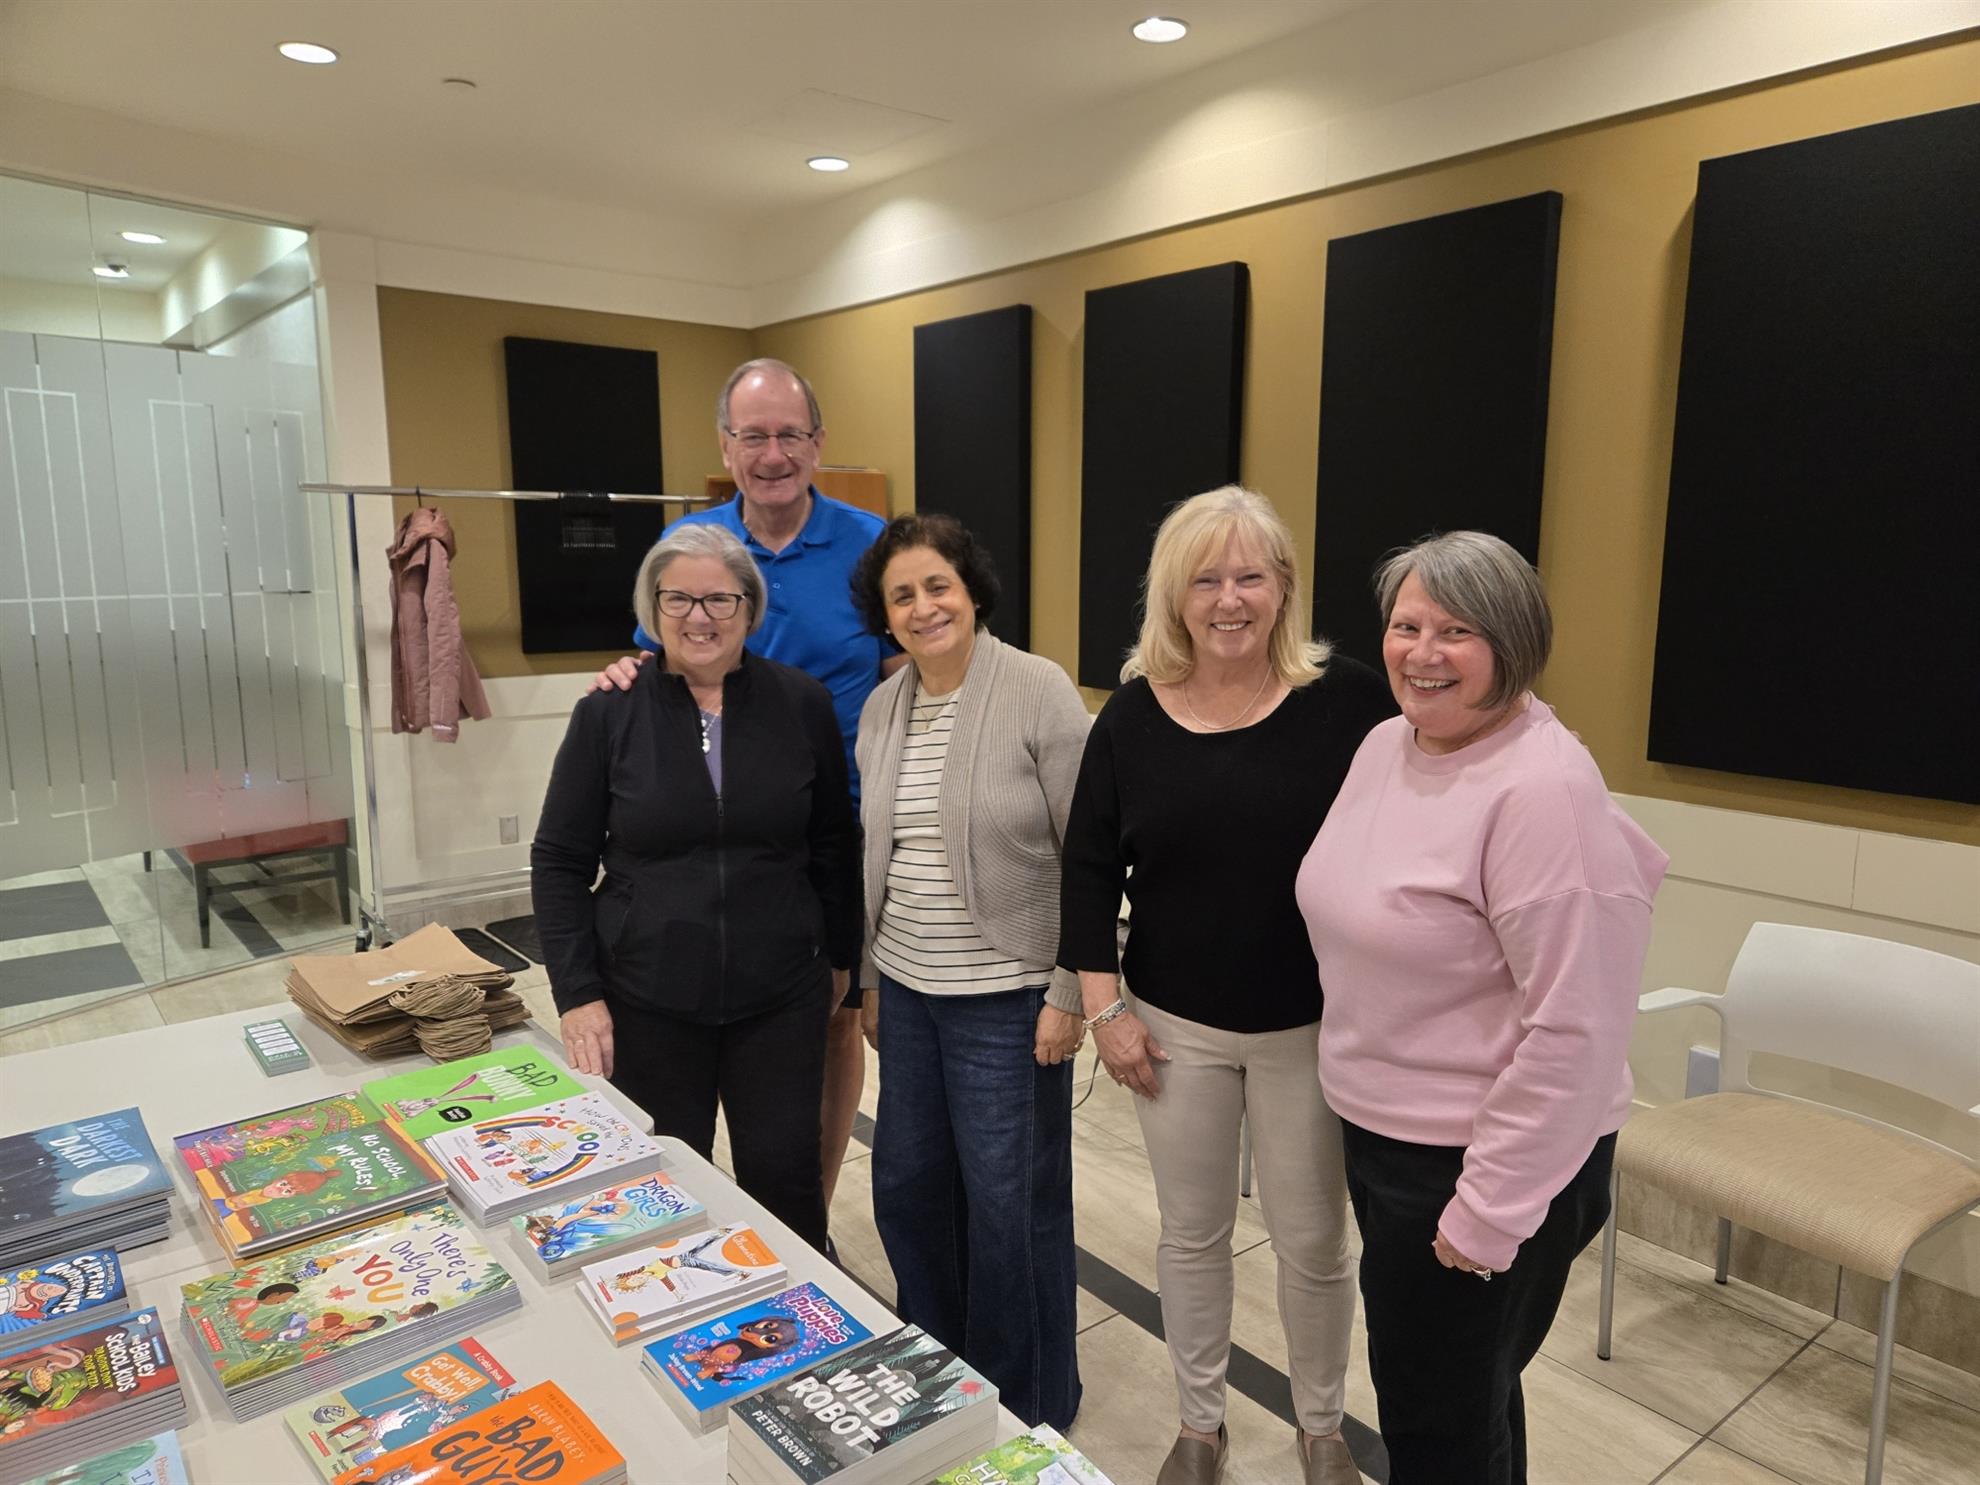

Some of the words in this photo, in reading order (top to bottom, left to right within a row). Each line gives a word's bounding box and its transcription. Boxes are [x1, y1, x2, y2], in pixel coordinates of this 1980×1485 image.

[504, 1063, 558, 1087] BAD
[77, 1122, 143, 1162] DARKEST
[104, 1118, 130, 1130] THE
[48, 1134, 110, 1169] DARK
[624, 1188, 668, 1218] GIRLS
[640, 1176, 691, 1216] DRAGON
[389, 1240, 434, 1272] Only
[430, 1232, 476, 1278] There's
[44, 1262, 85, 1314] UNDERPANTS
[72, 1255, 106, 1300] CAPTAIN
[352, 1254, 405, 1303] YOU
[411, 1268, 442, 1296] One
[785, 1295, 848, 1345] Puppies
[105, 1332, 131, 1371] SCHOOL
[431, 1356, 456, 1372] Get
[112, 1366, 137, 1393] KIDS
[410, 1365, 468, 1402] Crabby!
[826, 1368, 900, 1427] WILD
[866, 1363, 922, 1407] THE
[786, 1376, 881, 1448] ROBOT
[484, 1415, 565, 1481] BAD
[751, 1405, 783, 1437] PETER
[777, 1435, 813, 1467] BROWN
